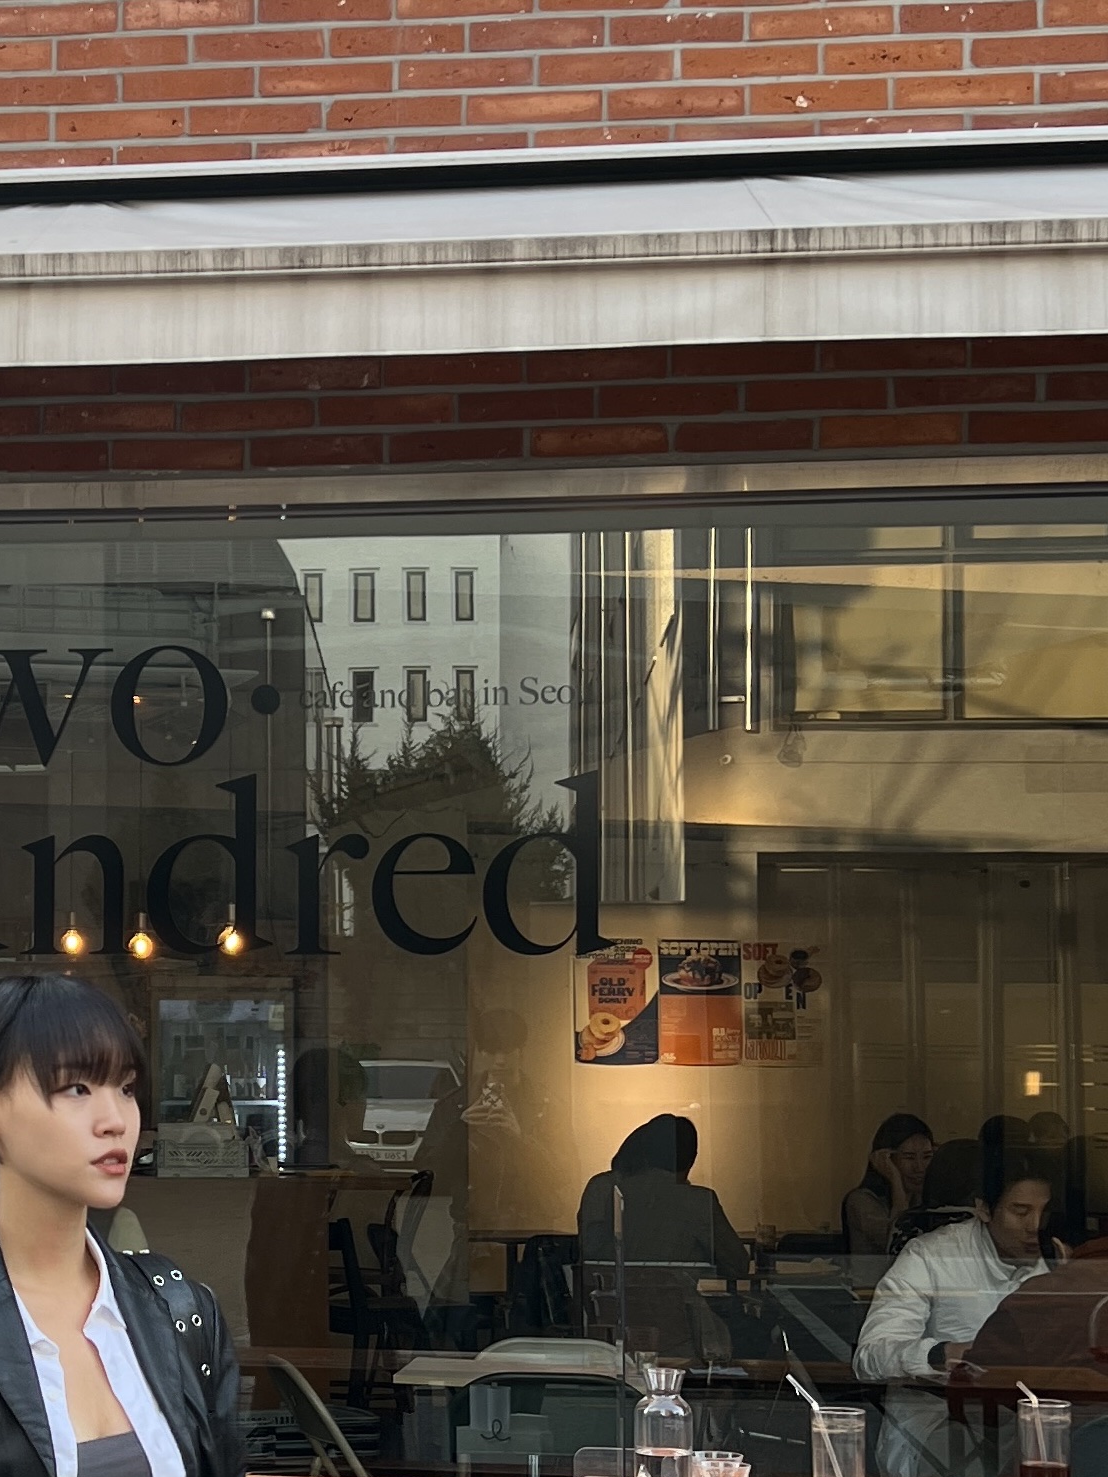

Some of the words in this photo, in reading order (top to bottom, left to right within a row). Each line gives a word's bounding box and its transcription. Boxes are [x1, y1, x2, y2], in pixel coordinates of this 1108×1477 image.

[483, 678, 510, 706] in
[659, 941, 699, 956] SOFT
[742, 943, 779, 961] SOFT
[598, 977, 626, 987] OLD
[590, 984, 636, 997] FERRY
